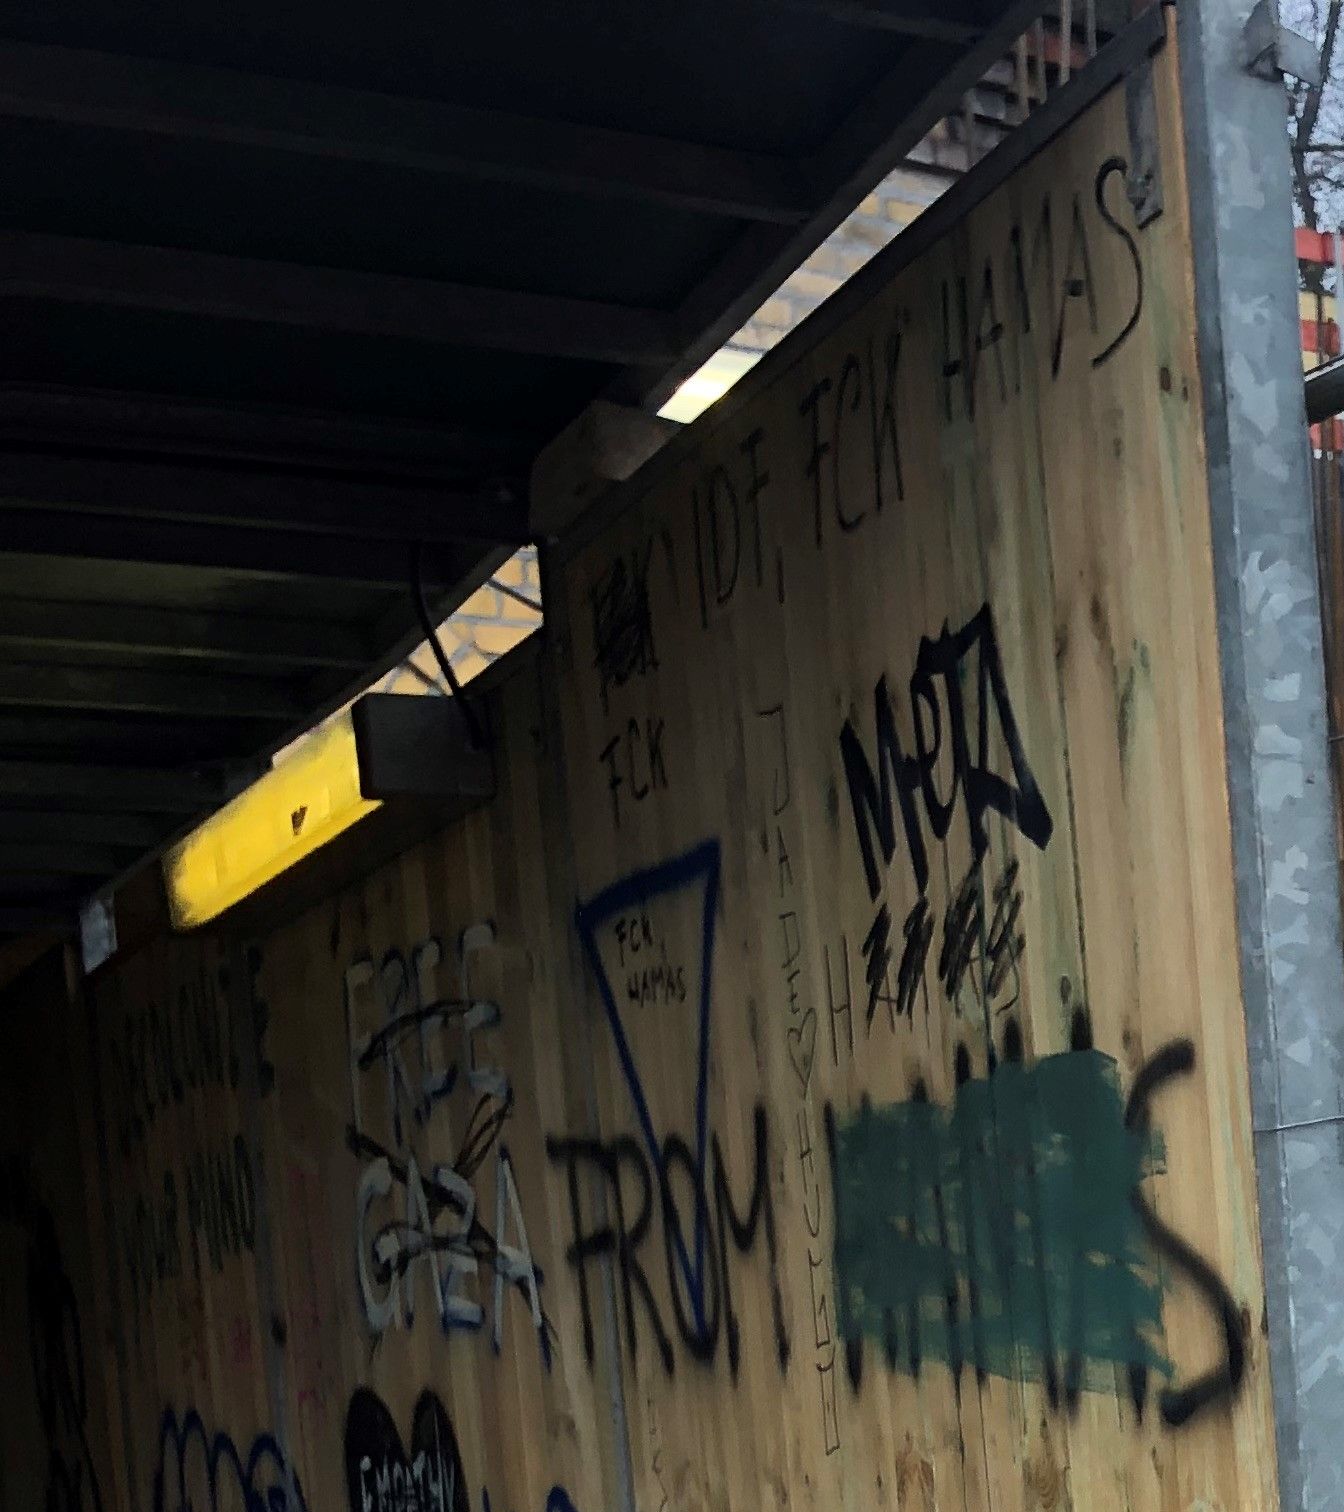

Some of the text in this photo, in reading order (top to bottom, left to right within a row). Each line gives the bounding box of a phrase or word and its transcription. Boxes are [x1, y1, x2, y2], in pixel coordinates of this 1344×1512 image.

[800, 330, 904, 550] FCK
[940, 155, 1143, 424] HAMAS
[600, 717, 668, 828] FCK
[614, 911, 653, 967] FCK
[627, 966, 686, 1008] HAMAS
[344, 918, 513, 1146] FREE
[186, 1135, 256, 1278] MIND
[356, 1146, 552, 1370] GAZA
[546, 1102, 791, 1389] FROM
